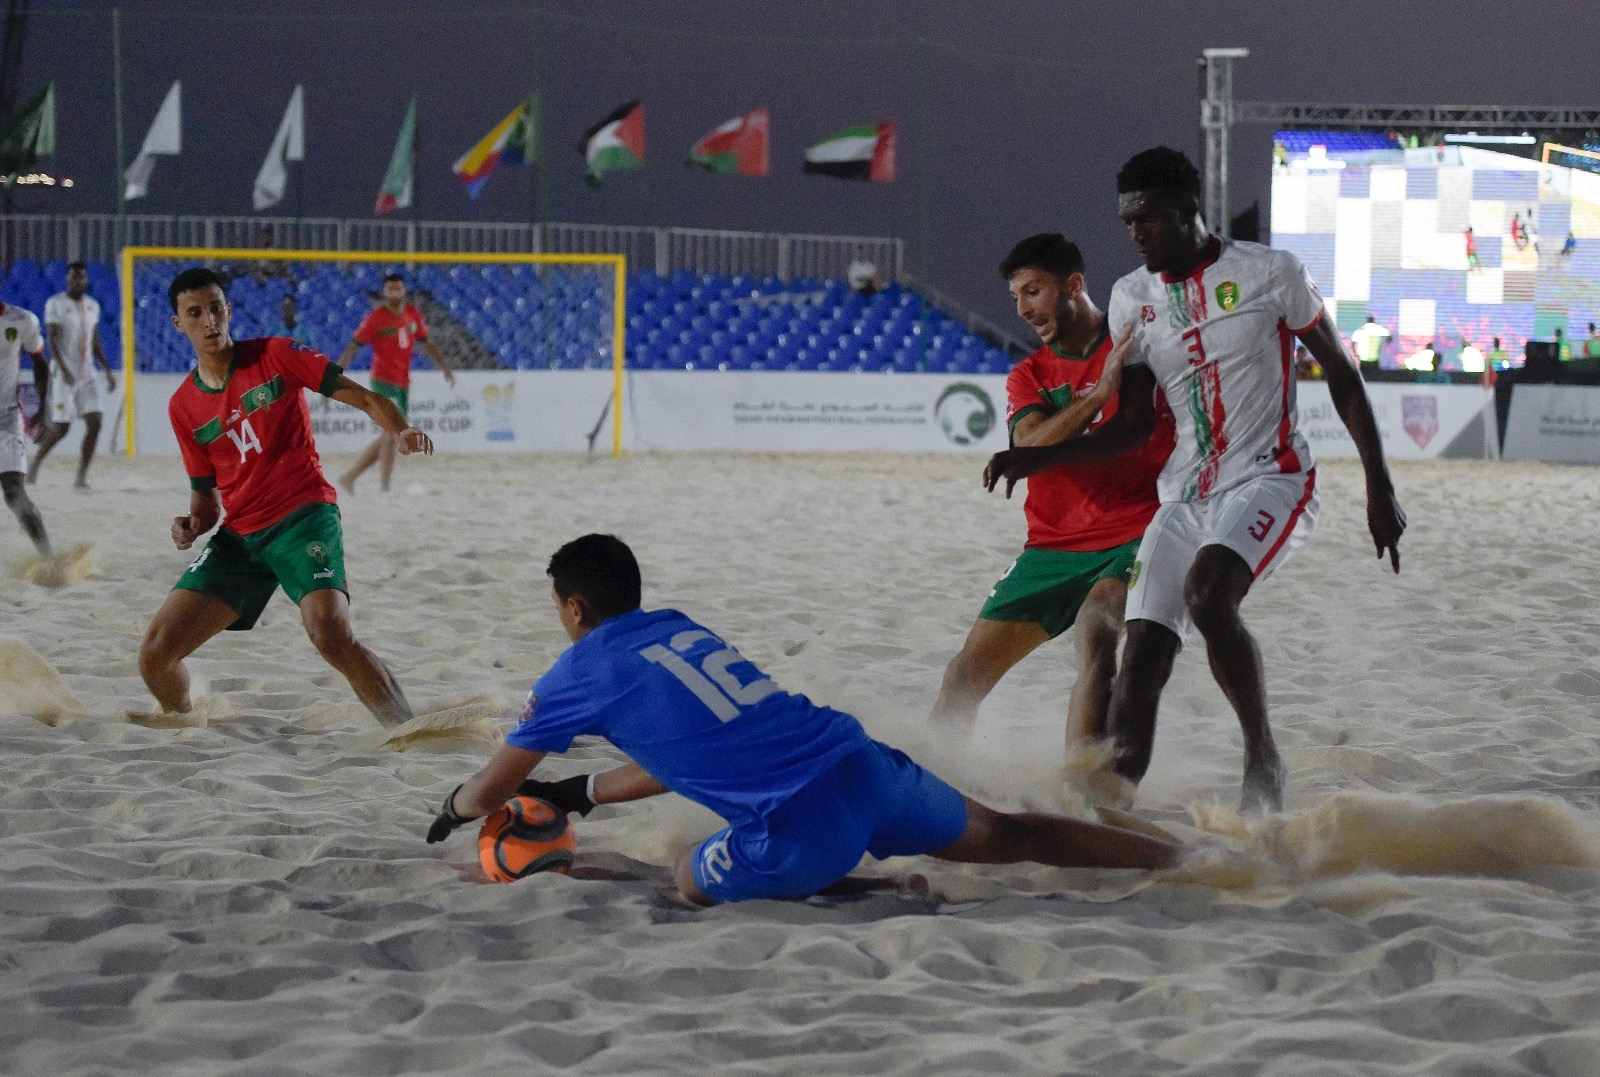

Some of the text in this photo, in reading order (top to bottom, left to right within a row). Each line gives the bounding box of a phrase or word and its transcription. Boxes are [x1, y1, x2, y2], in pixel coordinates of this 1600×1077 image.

[1181, 326, 1206, 367] 3
[226, 418, 263, 464] 14
[311, 418, 366, 434] BEACH
[438, 416, 472, 433] CUP
[1247, 508, 1276, 543] 3
[639, 629, 783, 724] 12
